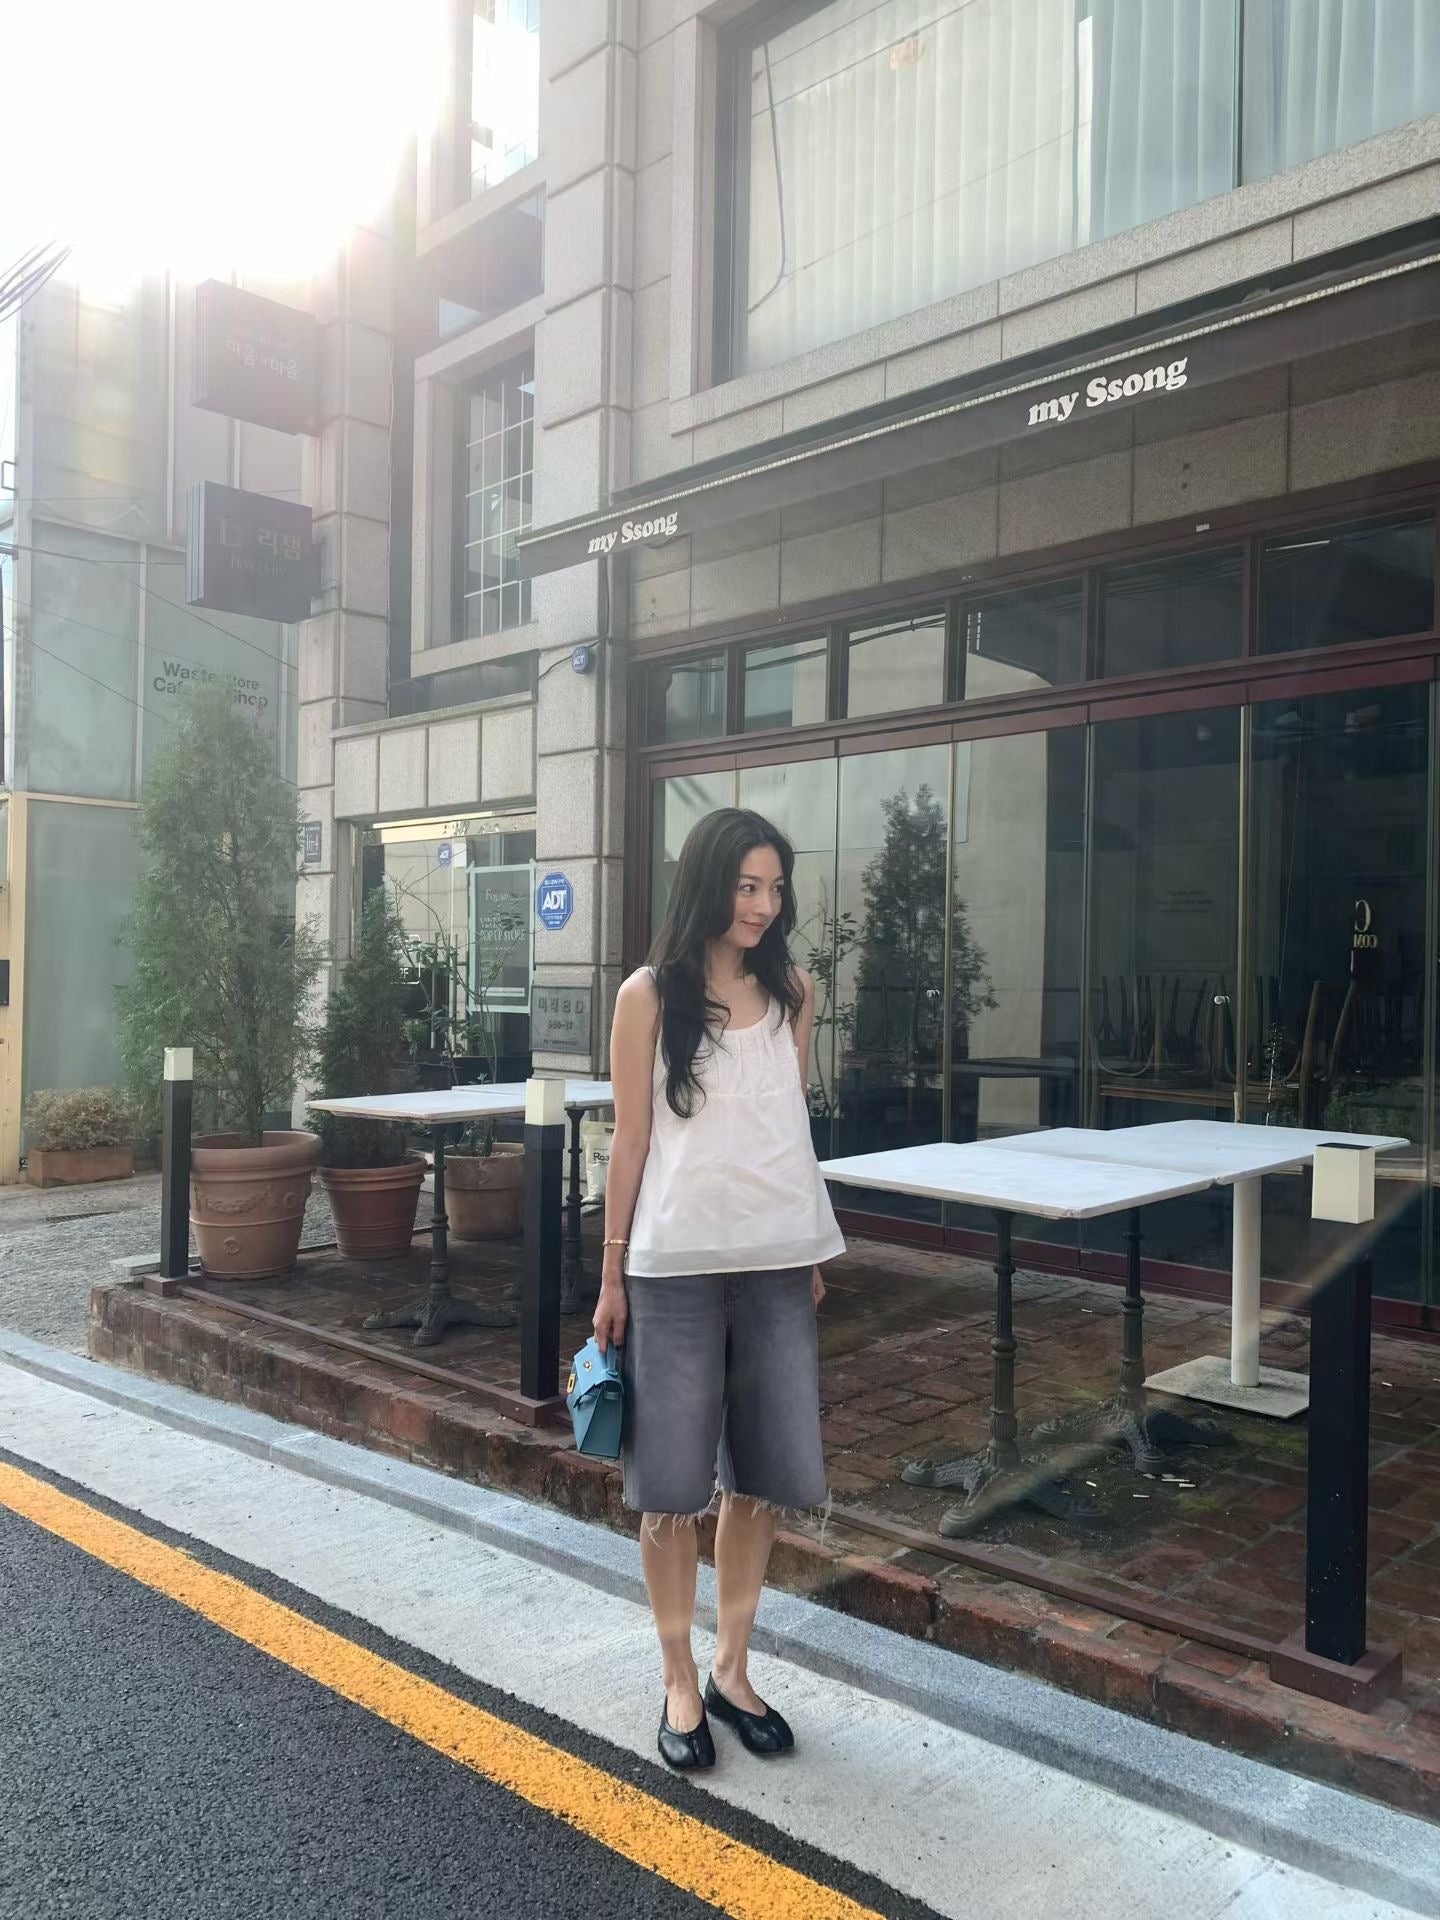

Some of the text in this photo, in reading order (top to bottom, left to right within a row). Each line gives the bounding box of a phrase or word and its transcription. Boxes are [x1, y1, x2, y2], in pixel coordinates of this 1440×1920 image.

[1028, 357, 1188, 425] my Ssong
[587, 512, 678, 553] my Ssong
[226, 674, 259, 690] tore
[542, 890, 567, 911] ADT
[593, 1152, 610, 1162] Roa
